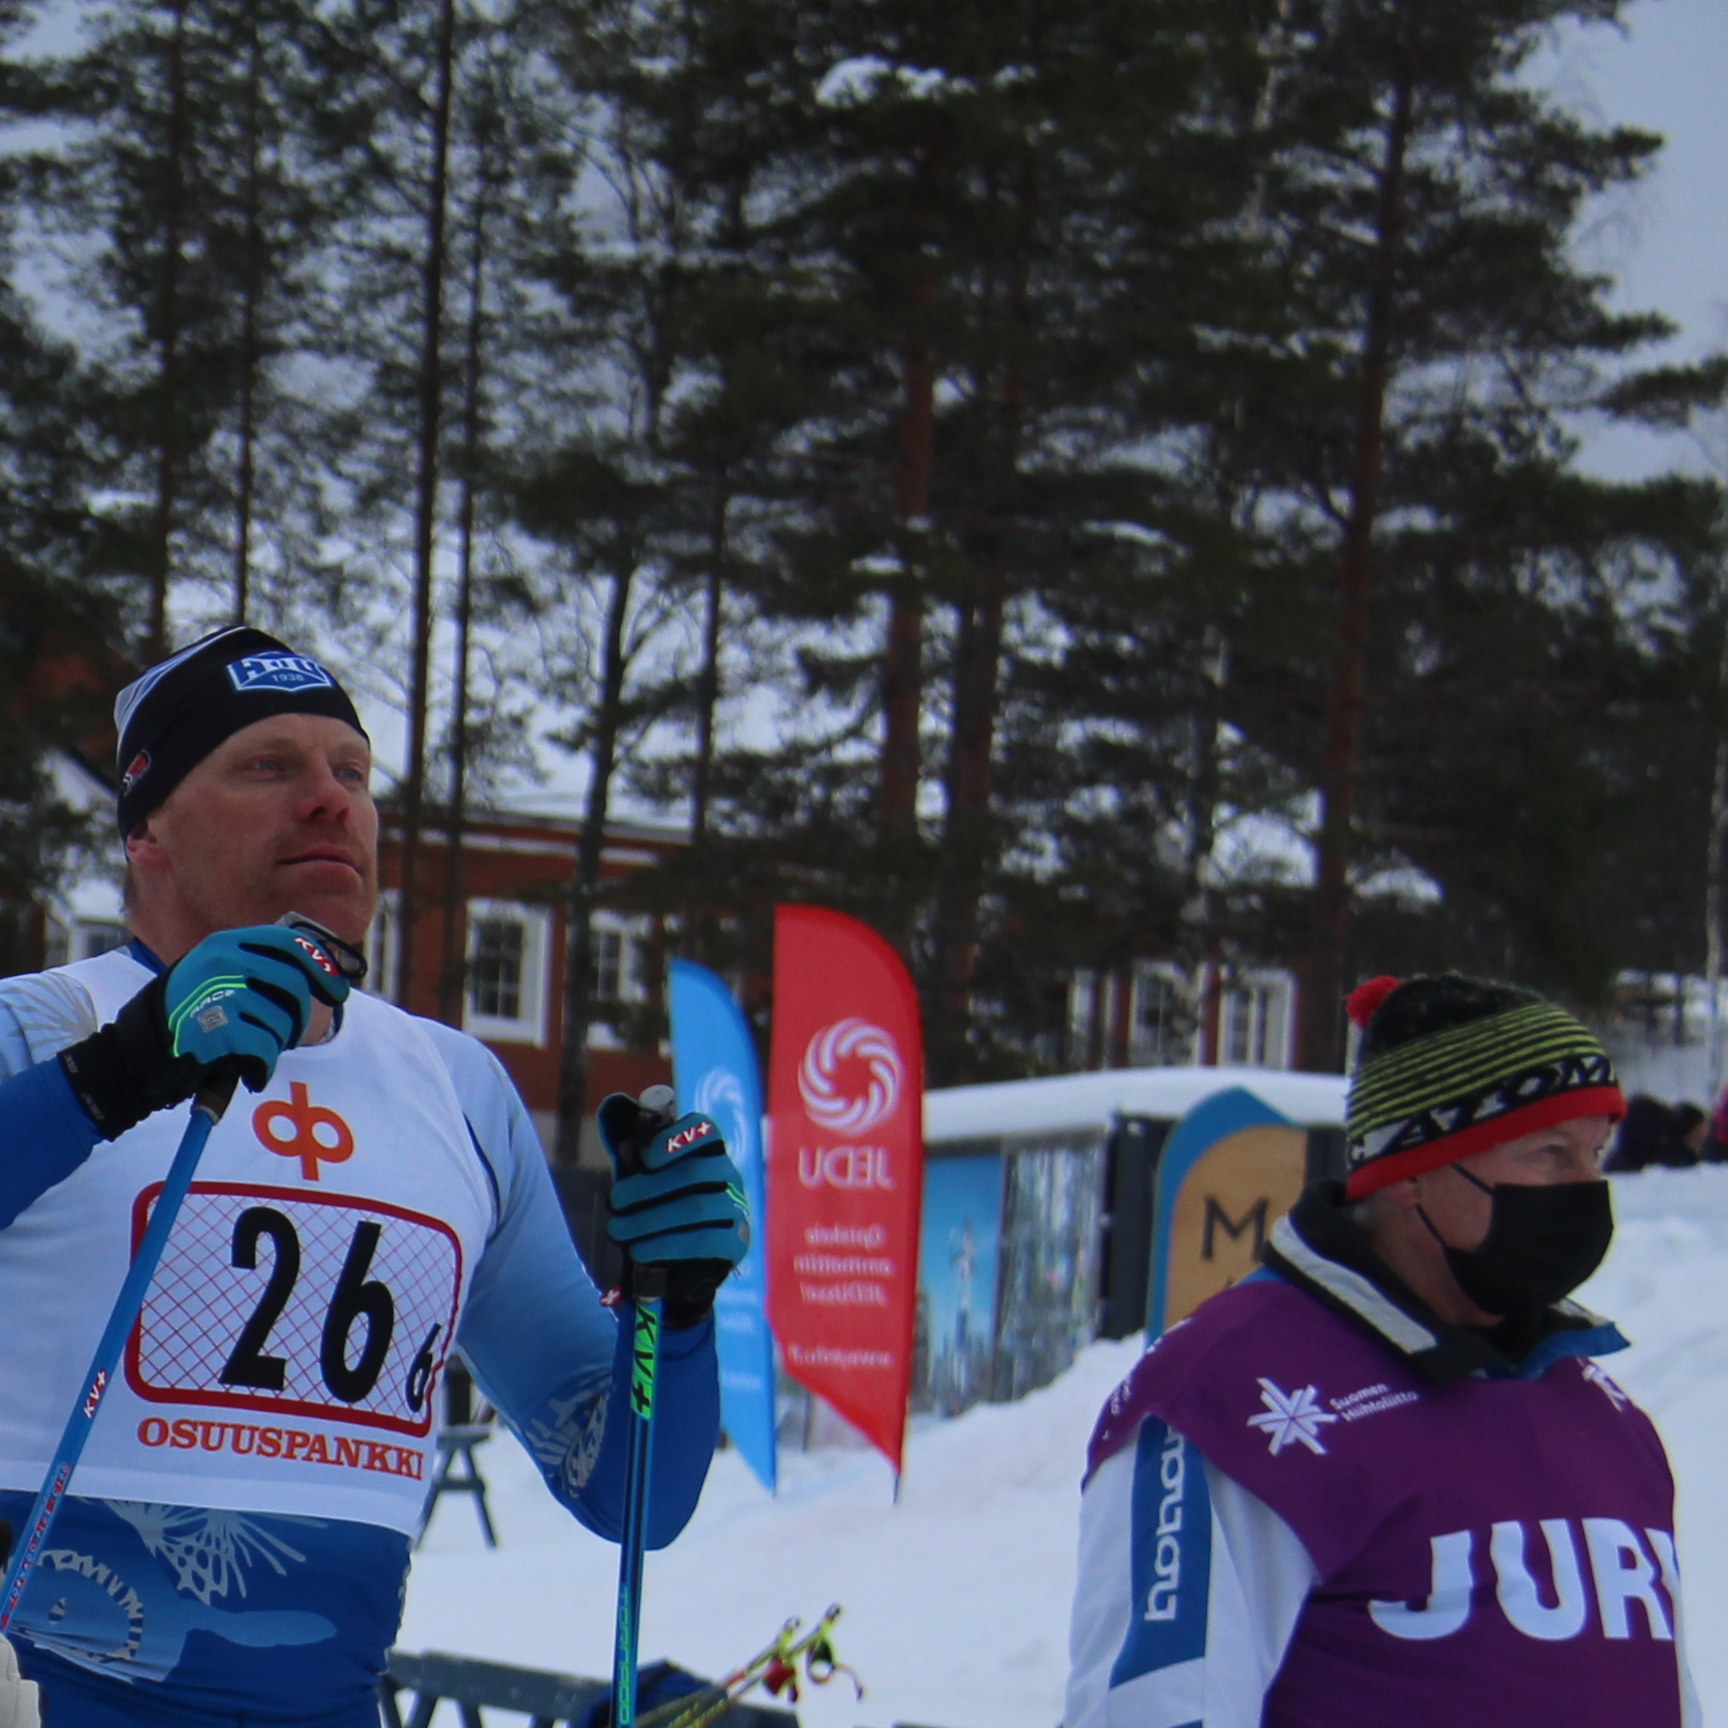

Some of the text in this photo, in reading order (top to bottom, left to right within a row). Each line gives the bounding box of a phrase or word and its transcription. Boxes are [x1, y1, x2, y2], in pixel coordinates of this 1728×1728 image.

[666, 1120, 712, 1154] KV+
[1200, 1194, 1268, 1261] M
[216, 1205, 396, 1404] 26
[83, 1368, 108, 1418] KV+
[404, 1323, 442, 1414] 6
[632, 1307, 657, 1418] KV+
[136, 1416, 425, 1482] OSUUSPANKKI
